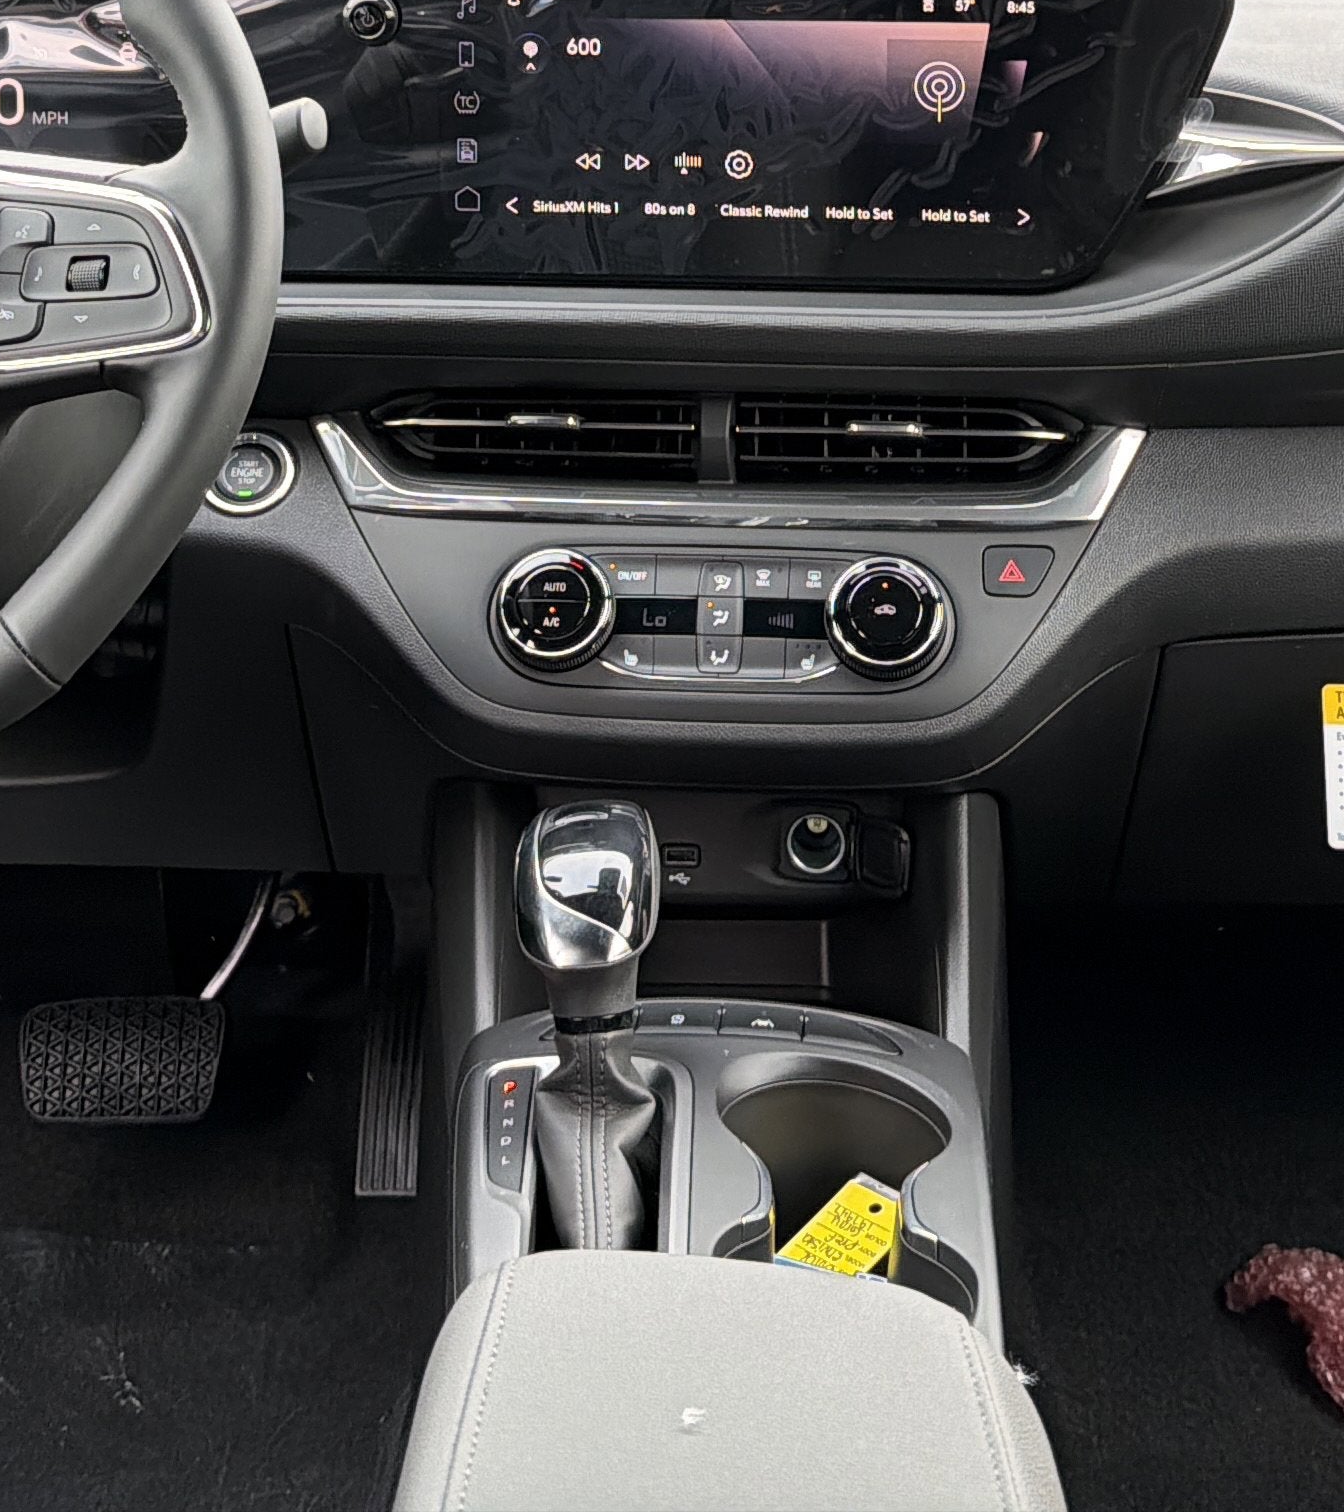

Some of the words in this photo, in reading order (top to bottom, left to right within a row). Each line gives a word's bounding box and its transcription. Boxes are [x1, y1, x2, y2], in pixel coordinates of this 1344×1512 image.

[1006, 1, 1036, 14] 8:45
[566, 38, 601, 56] 600
[32, 111, 69, 125] MPH
[533, 200, 585, 213] SiriusXM
[587, 201, 611, 214] Hits
[613, 202, 619, 213] 1
[644, 202, 667, 215] 80s
[669, 206, 685, 215] on
[687, 203, 696, 216] 8
[720, 204, 762, 217] Classic
[764, 205, 809, 219] Rewind
[825, 206, 855, 220] Hold
[857, 209, 871, 220] to
[872, 207, 894, 221] Set
[922, 208, 951, 222] Hold
[953, 211, 967, 223] to
[969, 209, 991, 223] Set
[238, 460, 259, 468] START
[230, 468, 264, 478] ENGINE
[617, 571, 648, 581] ON/OFF
[543, 582, 567, 592] AUTO
[543, 617, 560, 627] A/C
[1337, 832, 1344, 841] To
[504, 1081, 518, 1096] P
[504, 1099, 514, 1109] R
[502, 1117, 513, 1128] N
[500, 1136, 511, 1146] D
